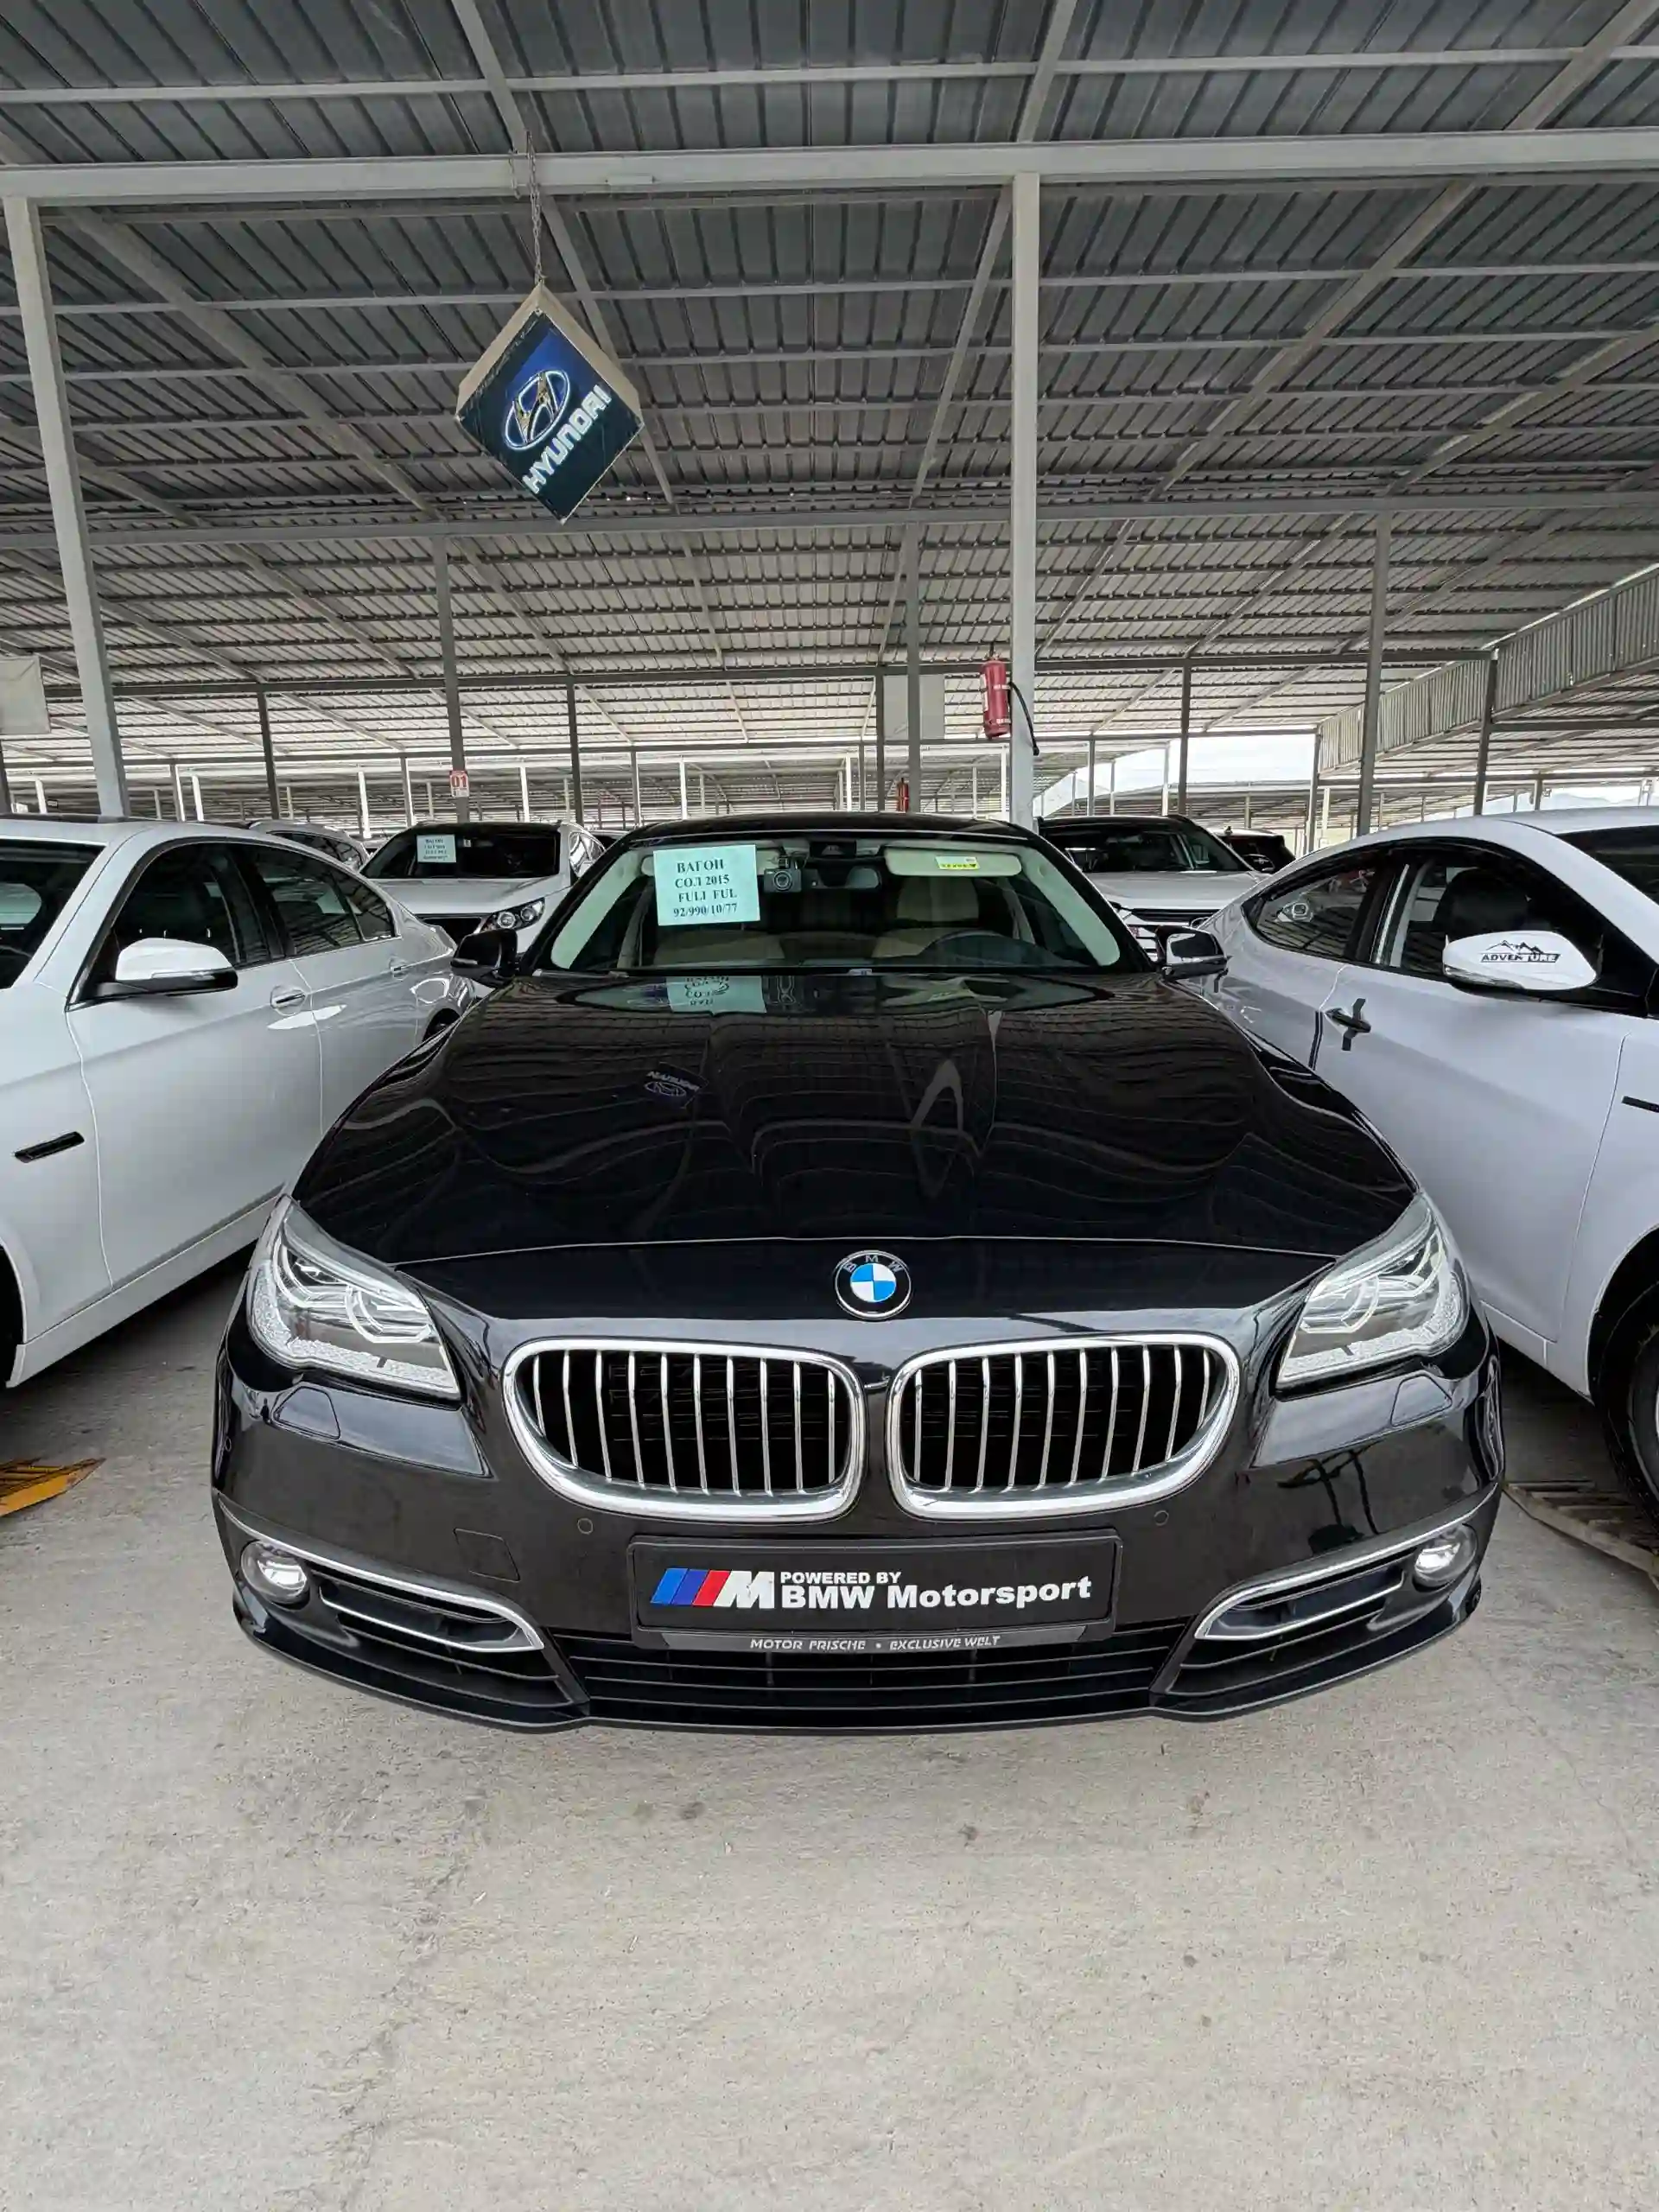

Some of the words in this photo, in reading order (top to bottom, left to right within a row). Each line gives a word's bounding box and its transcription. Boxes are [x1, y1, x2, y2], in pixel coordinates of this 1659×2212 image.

[522, 385, 613, 494] HYUNDAI
[705, 874, 730, 886] 2015
[842, 1254, 904, 1273] BMW
[780, 1572, 871, 1584] POWERED
[876, 1572, 901, 1584] BY
[781, 1586, 875, 1609] BMW
[887, 1575, 1092, 1609] Motorsport
[750, 1638, 803, 1649] MOTOR
[889, 1637, 962, 1651] EXCLUSIVE
